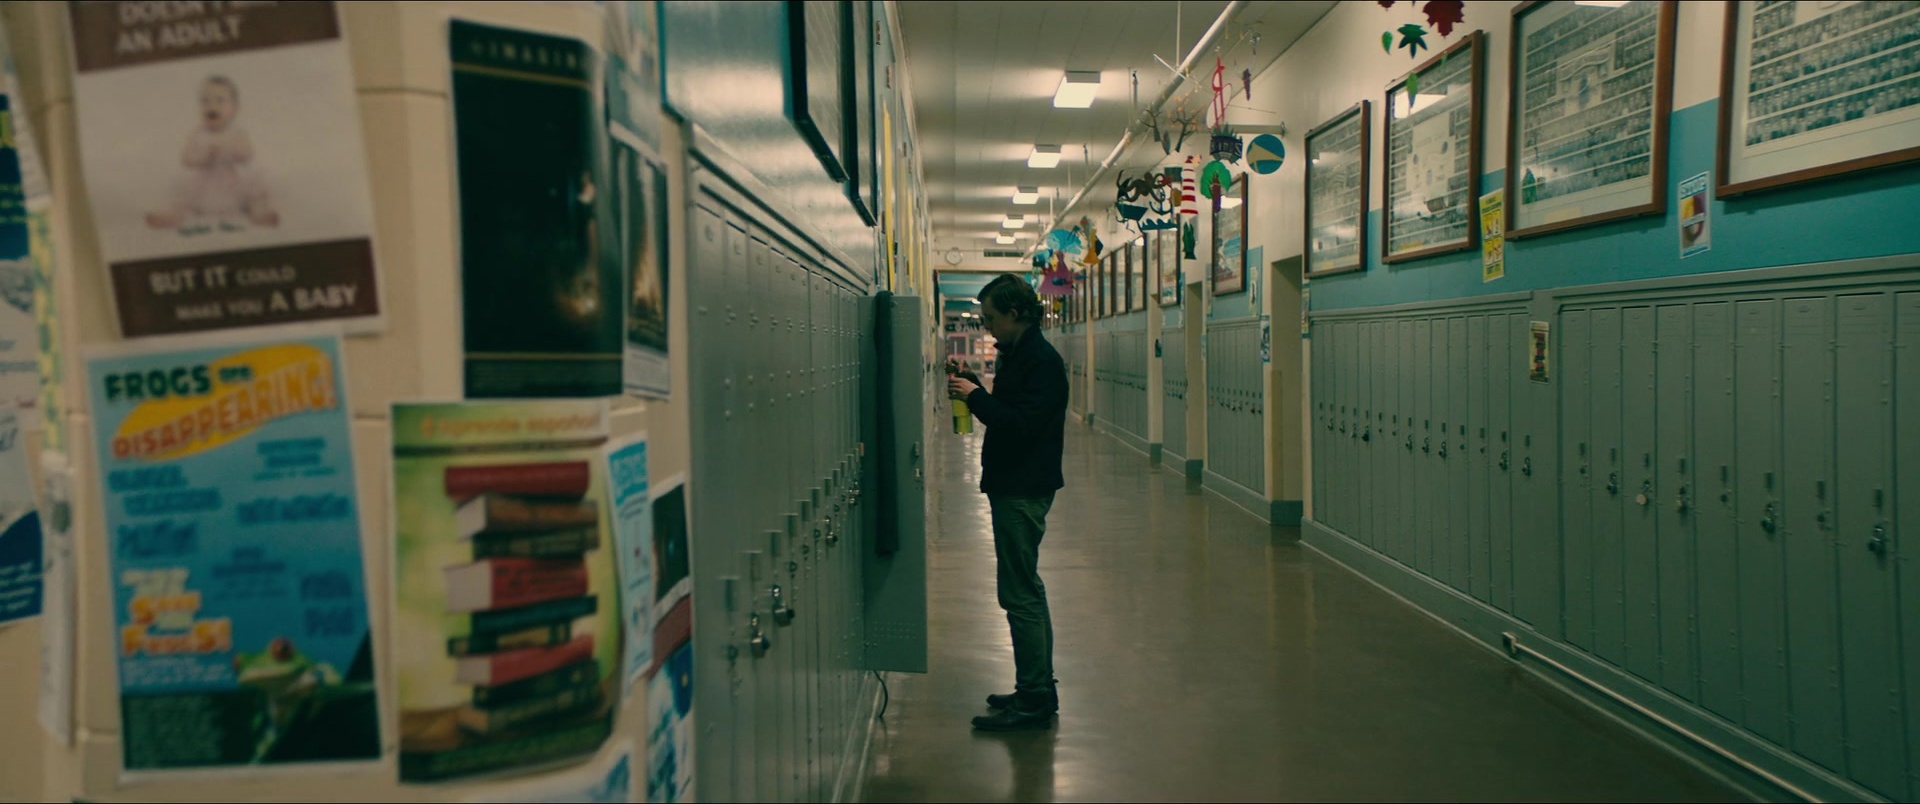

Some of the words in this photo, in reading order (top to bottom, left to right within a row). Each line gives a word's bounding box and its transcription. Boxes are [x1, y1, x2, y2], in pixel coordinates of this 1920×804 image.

[118, 2, 222, 25] DOESNT
[116, 32, 152, 53] AN
[158, 16, 242, 48] ADULT
[151, 268, 198, 294] BUT
[203, 265, 228, 289] IT
[269, 290, 290, 313] A
[294, 284, 358, 310] BABY
[104, 365, 211, 402] FROGS
[113, 357, 336, 459] DISAPPEARING!
